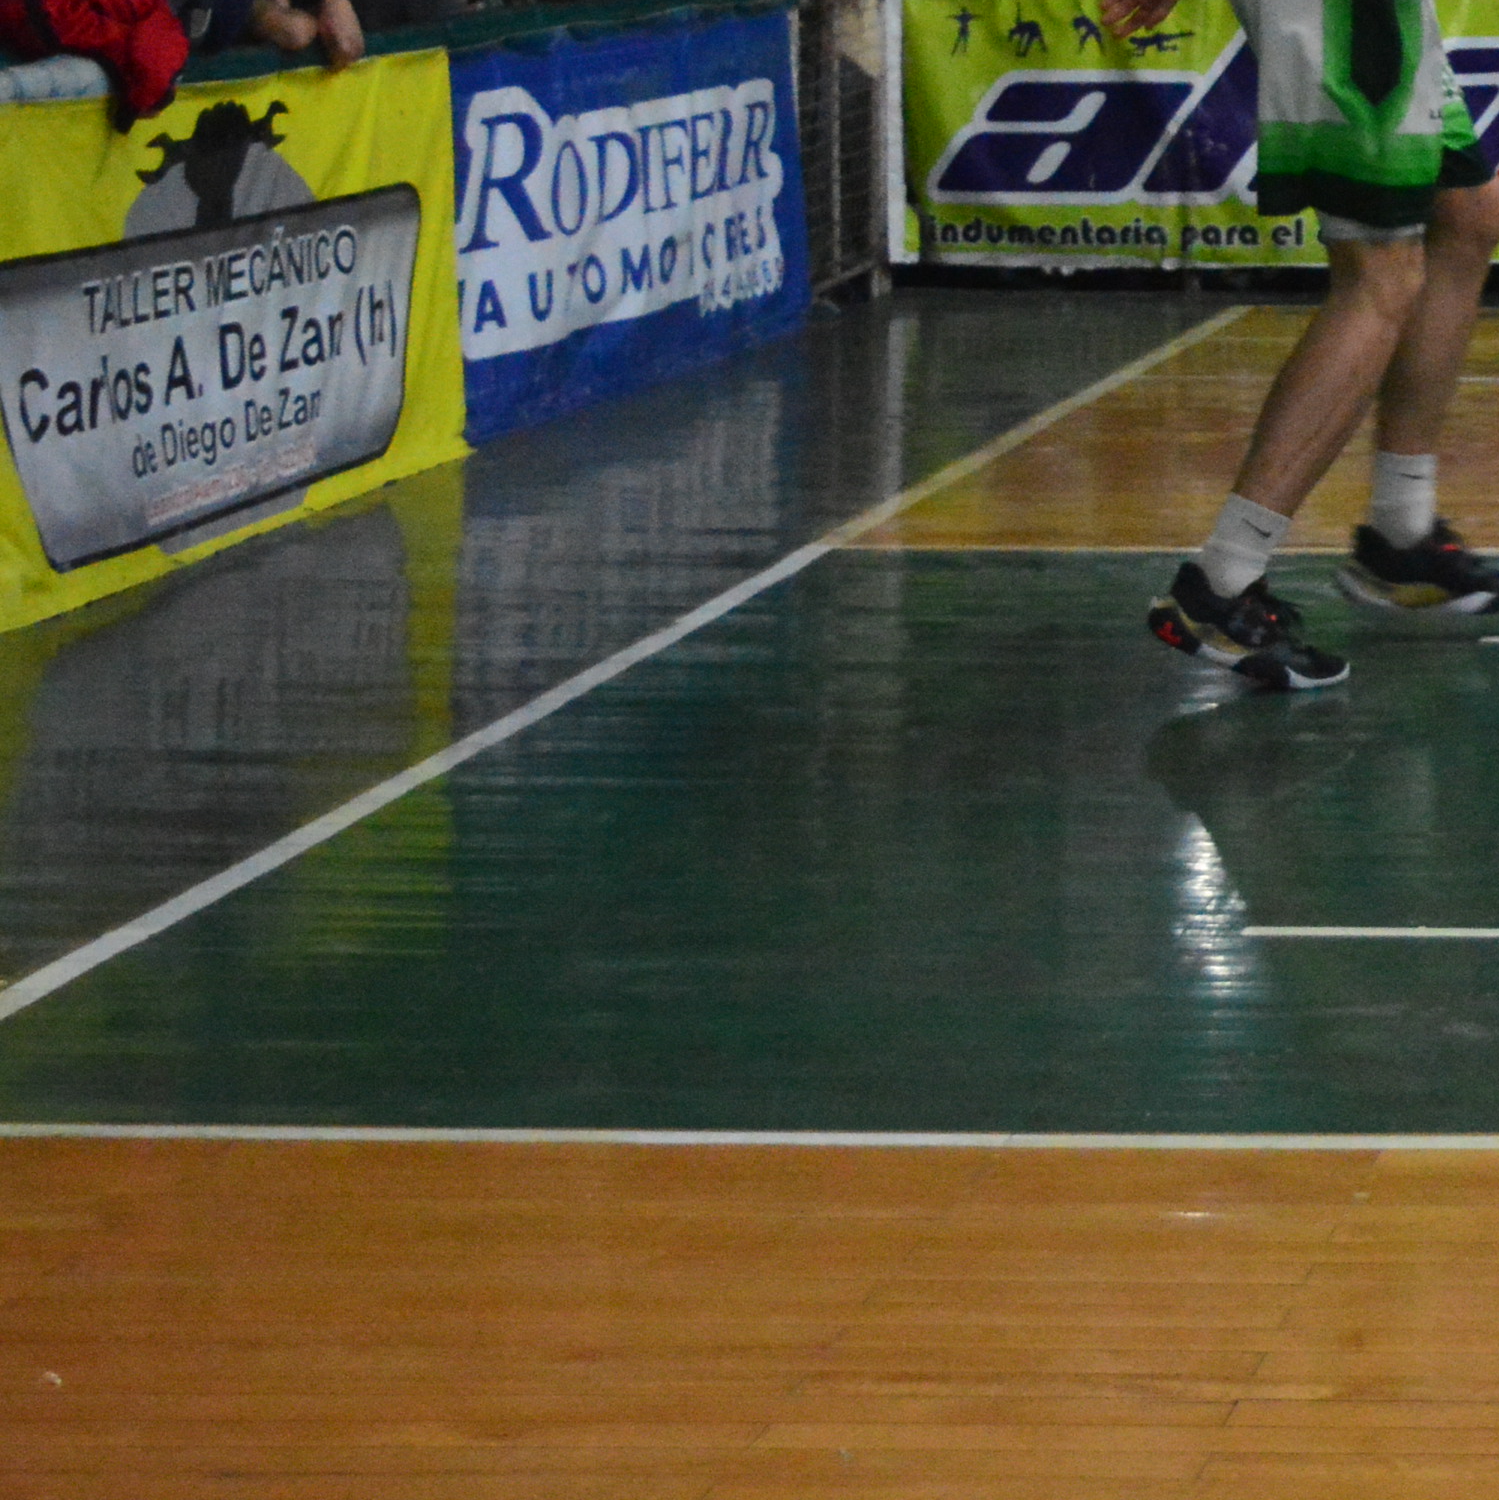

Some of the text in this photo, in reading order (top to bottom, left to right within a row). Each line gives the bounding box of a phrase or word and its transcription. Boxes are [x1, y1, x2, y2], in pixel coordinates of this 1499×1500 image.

[929, 216, 1306, 251] indumentaria para el
[83, 262, 196, 335] TALLER
[19, 354, 153, 444] Carlos
[164, 334, 204, 406] A.
[218, 321, 267, 391] De
[354, 278, 398, 366] (h)
[131, 433, 158, 480] de
[161, 414, 237, 468] Diego
[244, 399, 274, 443] De
